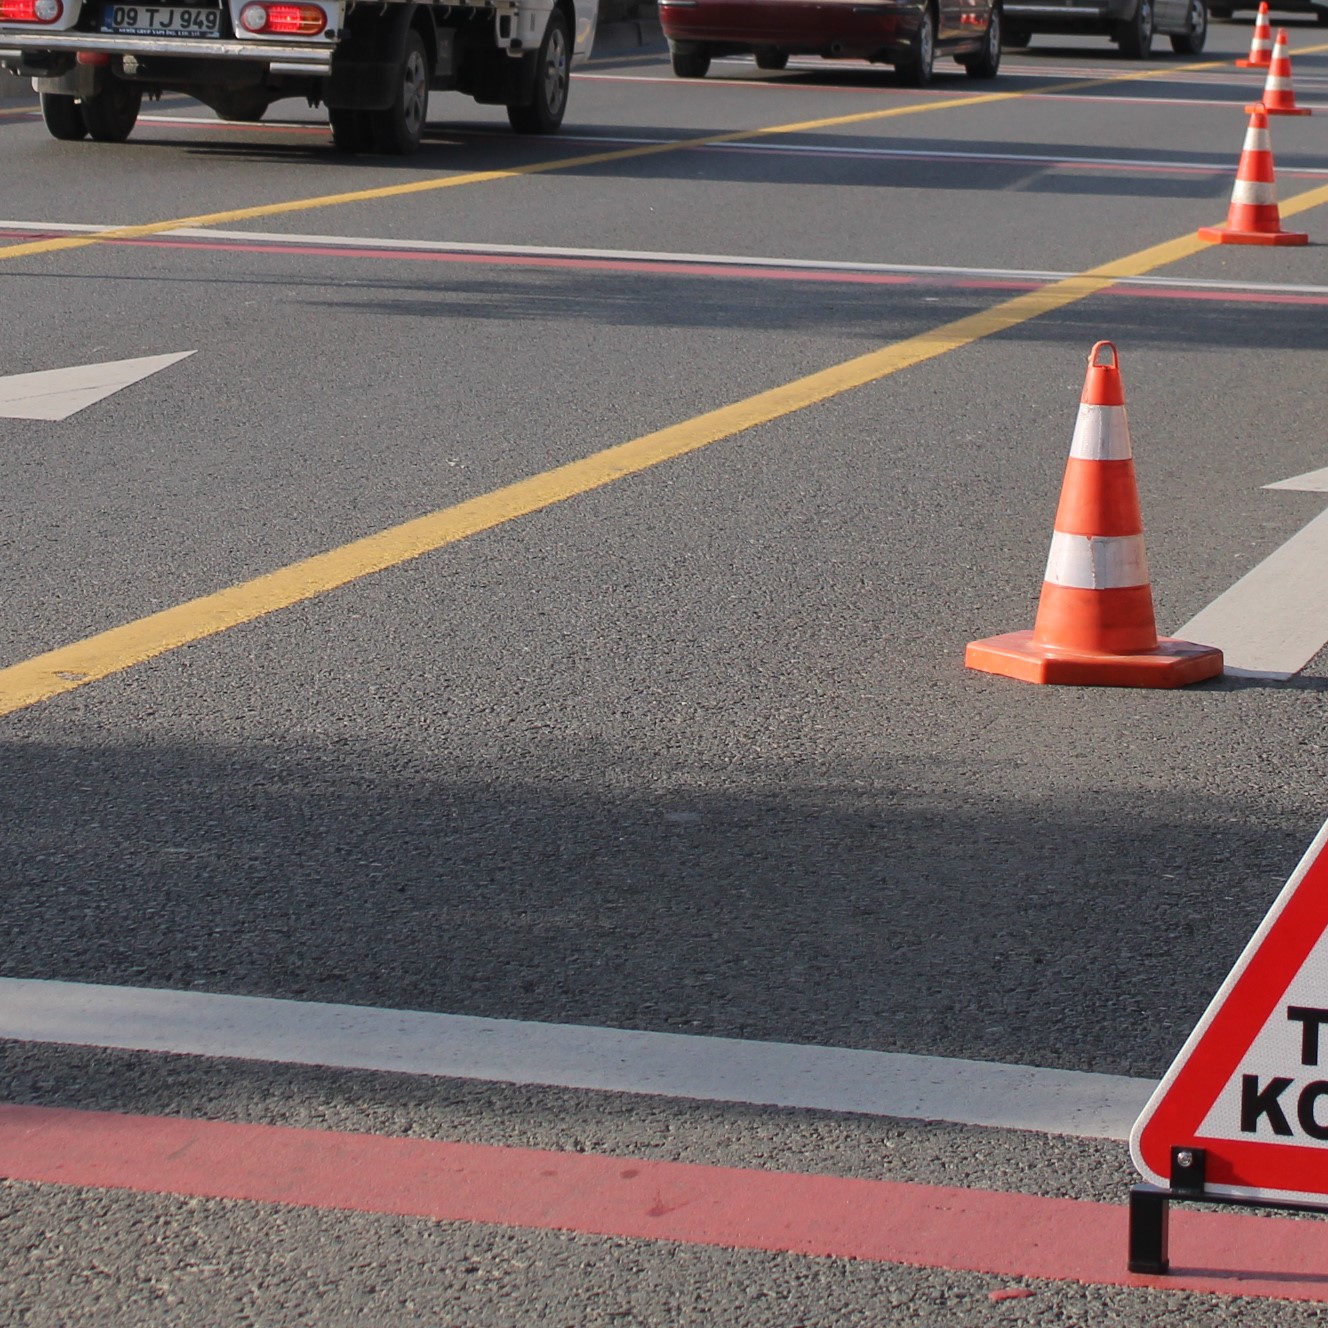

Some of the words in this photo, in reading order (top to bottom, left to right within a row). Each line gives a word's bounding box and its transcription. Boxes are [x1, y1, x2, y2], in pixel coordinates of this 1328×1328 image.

[113, 6, 138, 27] 09
[145, 8, 175, 28] TJ
[180, 9, 218, 30] 949
